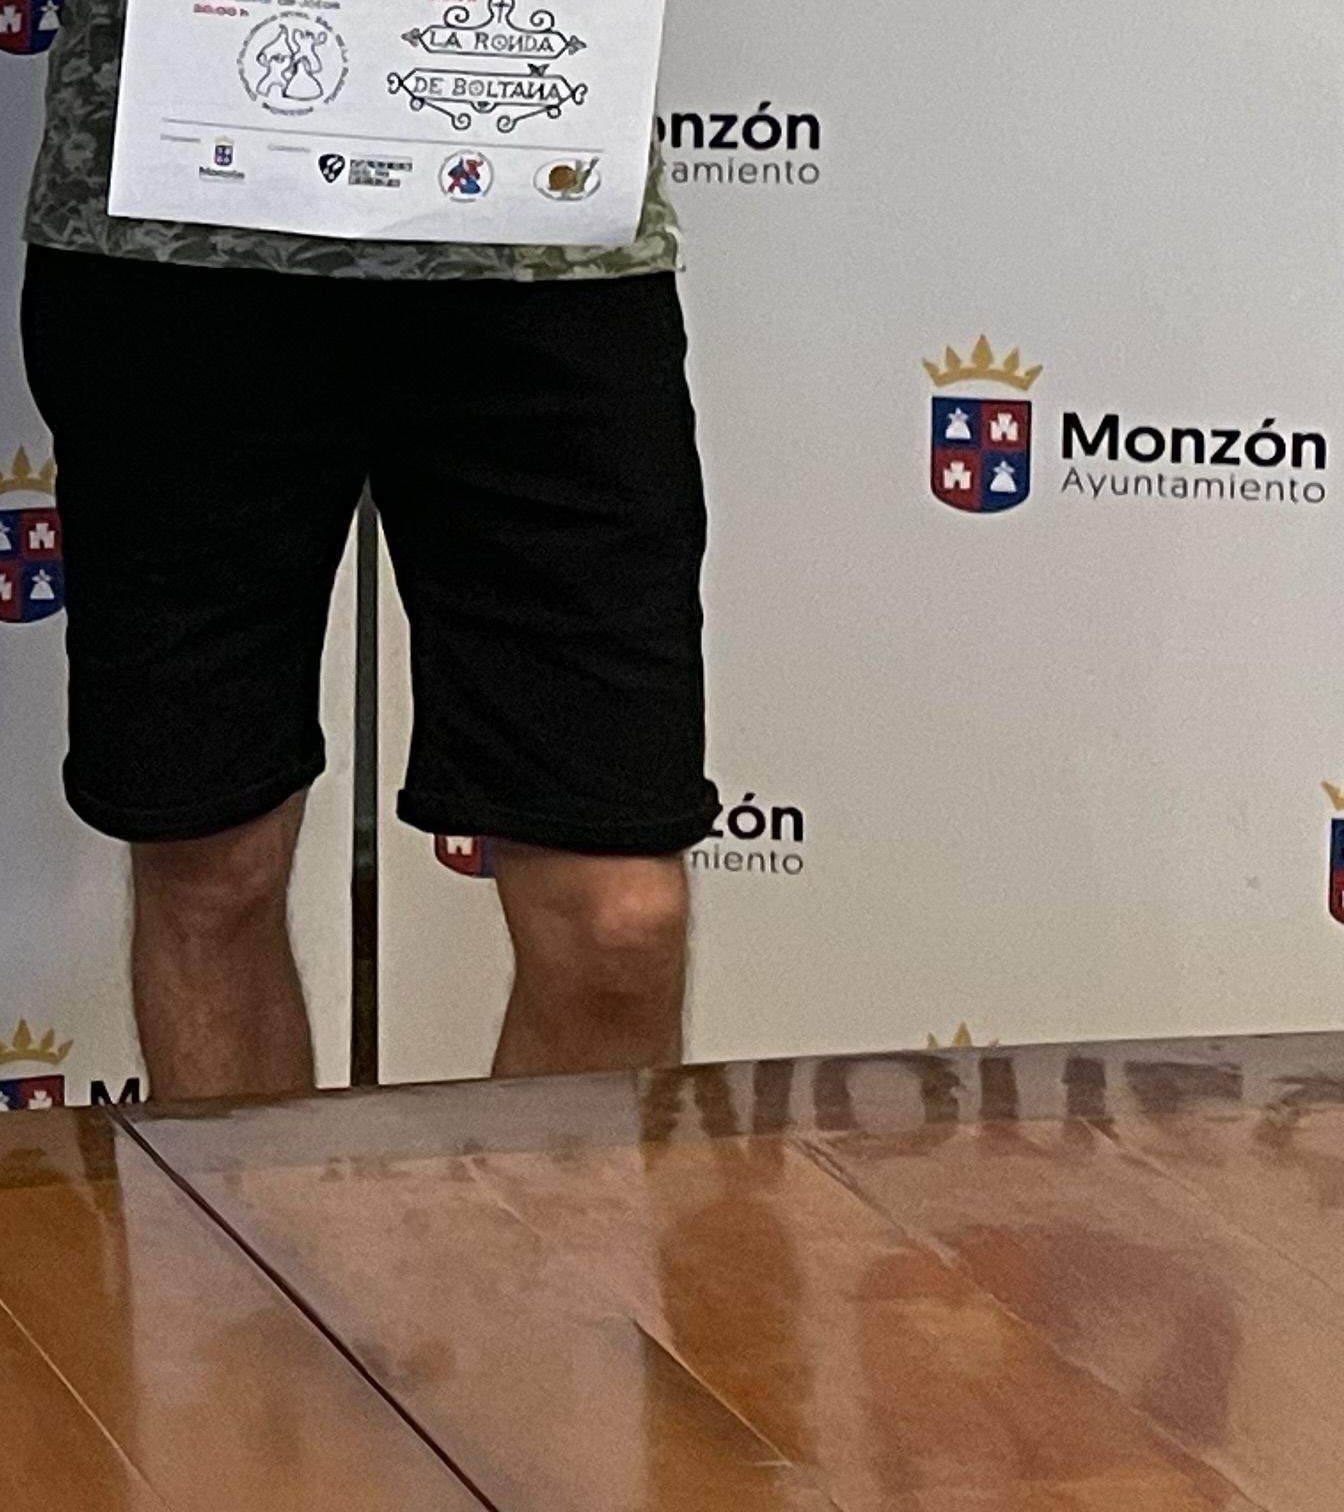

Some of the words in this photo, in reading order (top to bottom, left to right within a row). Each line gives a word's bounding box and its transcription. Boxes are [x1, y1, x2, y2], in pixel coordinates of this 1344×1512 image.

[430, 30, 461, 48] LA
[414, 77, 445, 94] DE
[656, 101, 820, 151] nzón
[670, 157, 820, 185] amiento
[1062, 412, 1327, 470] Monzón
[1062, 466, 1326, 504] Ayuntamiento
